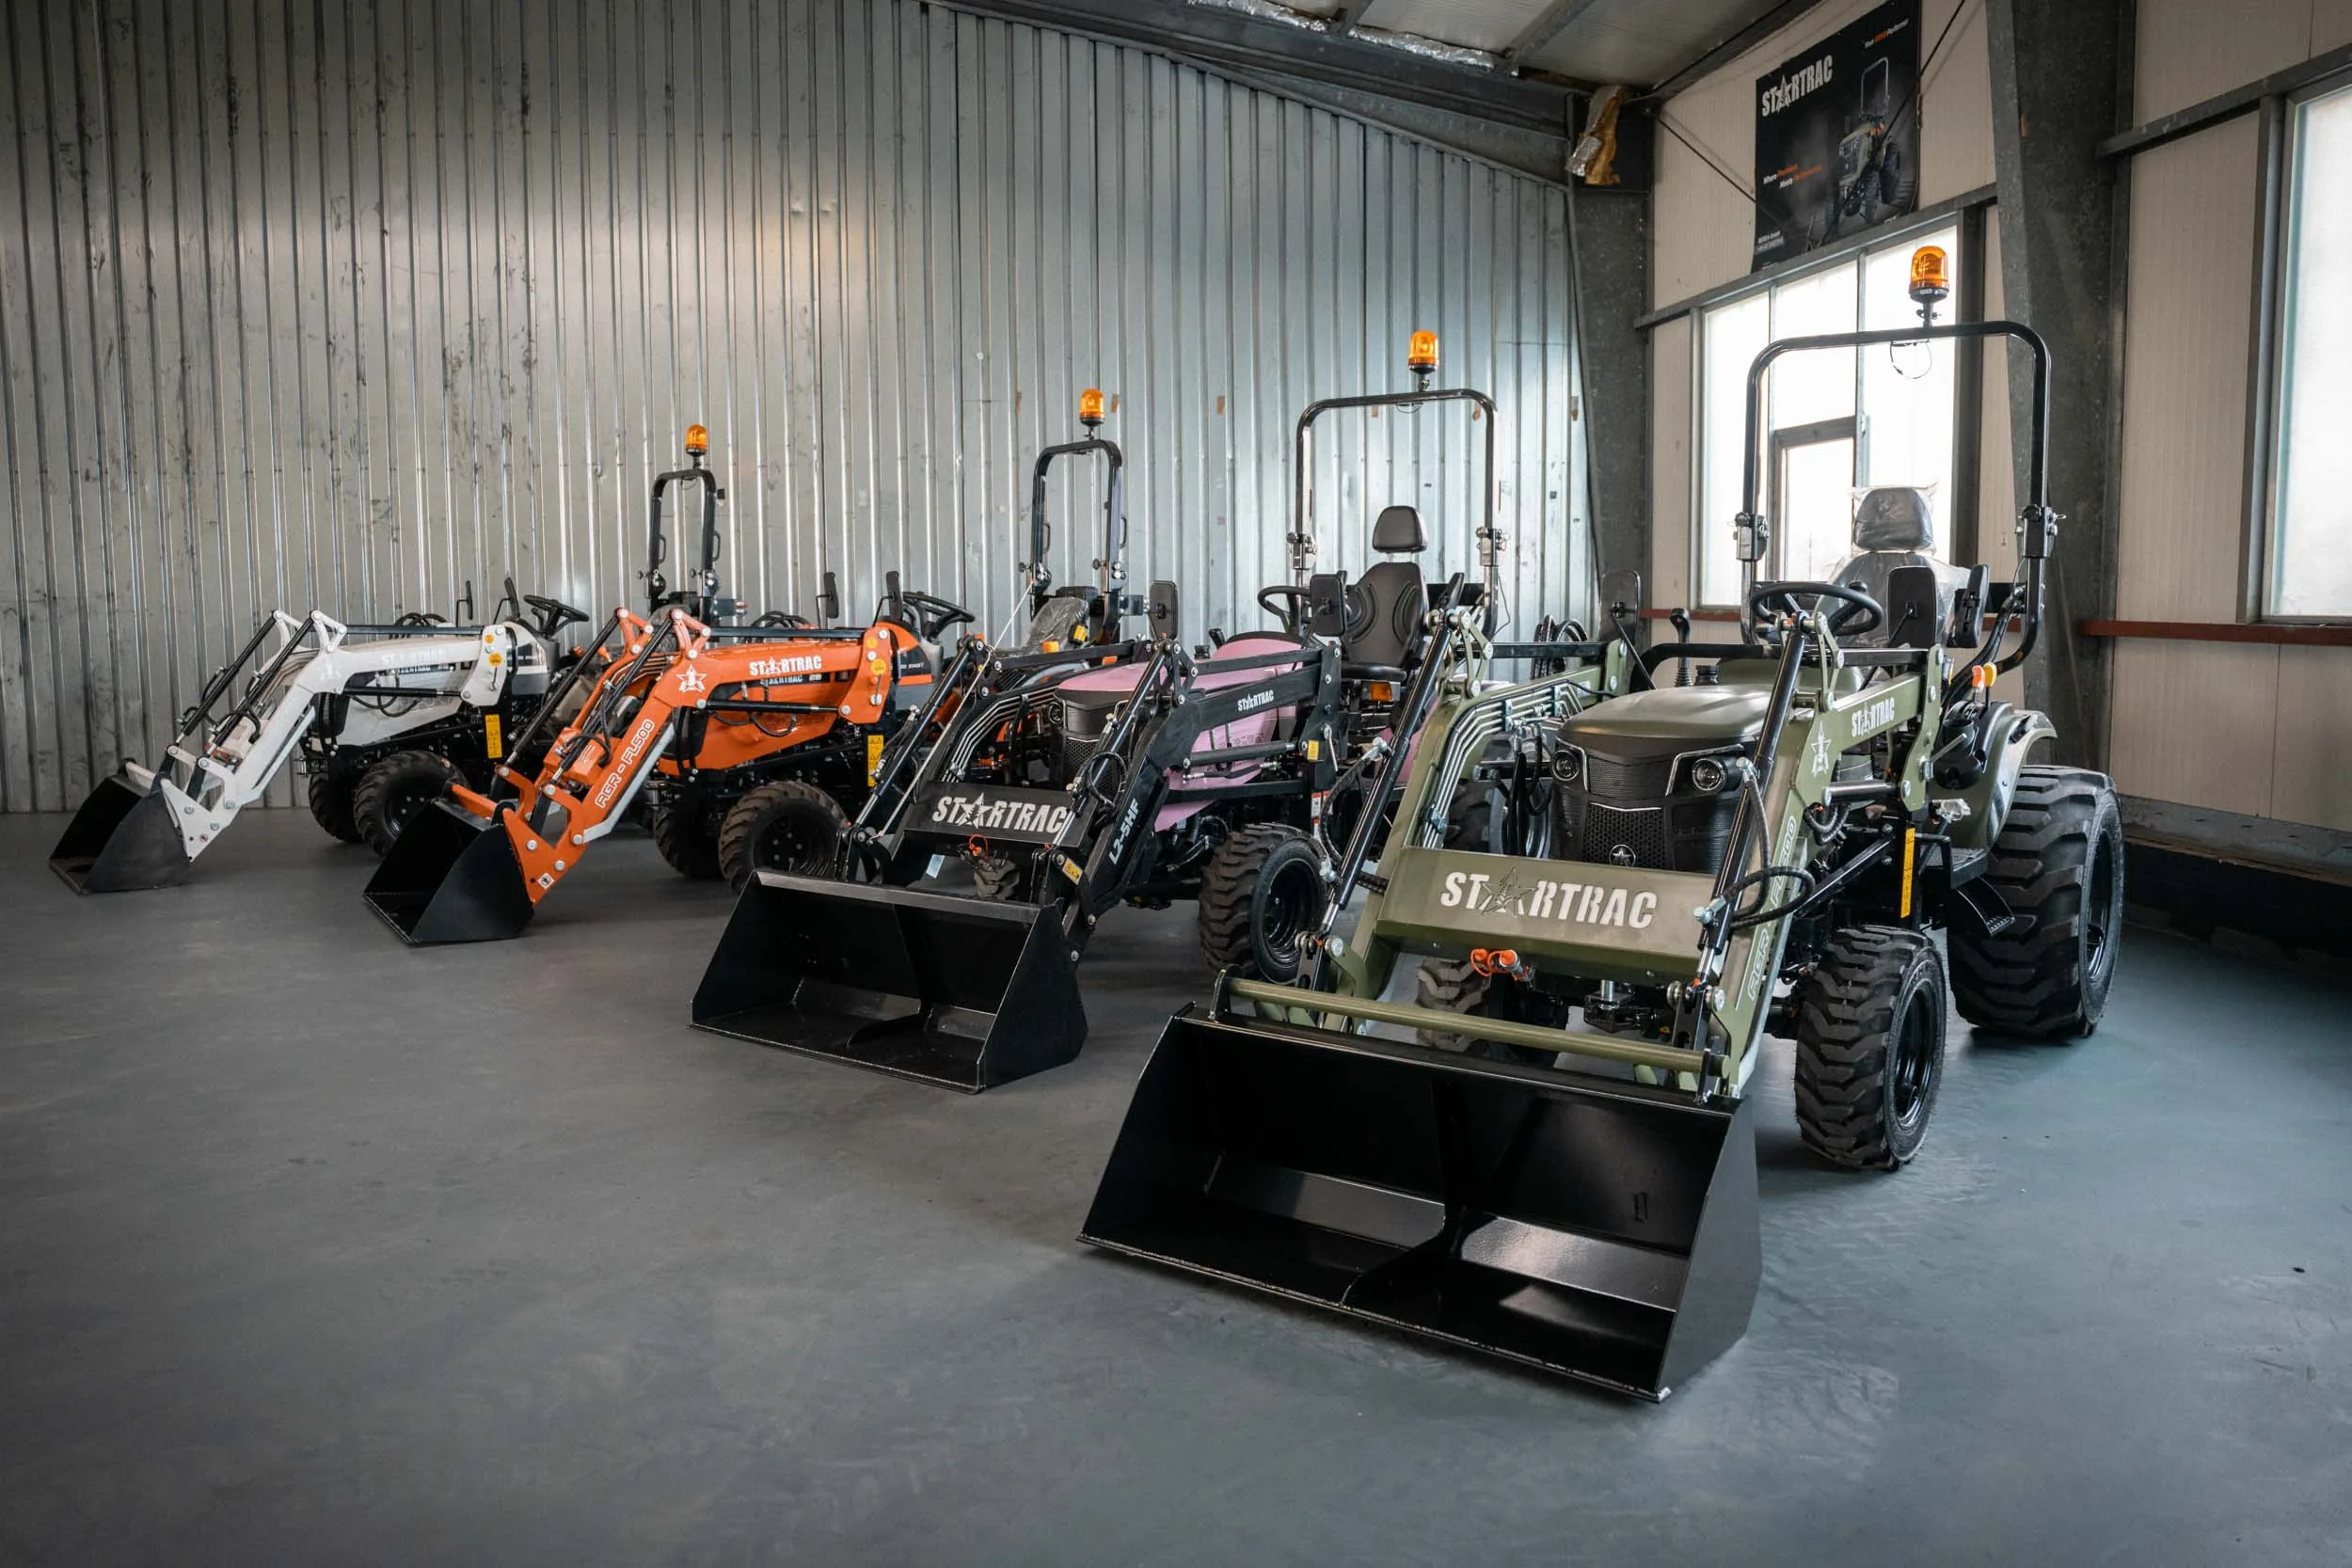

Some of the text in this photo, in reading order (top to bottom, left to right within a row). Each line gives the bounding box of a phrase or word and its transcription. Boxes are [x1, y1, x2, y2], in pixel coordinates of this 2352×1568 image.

[1761, 55, 1833, 117] STARTRAC
[749, 656, 822, 677] STARTRAC
[1237, 689, 1275, 712] STARTRAC
[1851, 697, 1895, 737] STARTRAC
[595, 772, 622, 808] AGR
[621, 719, 655, 765] FL500
[932, 792, 1068, 833] STARTRAC
[1440, 866, 1658, 929] STARTRAC
